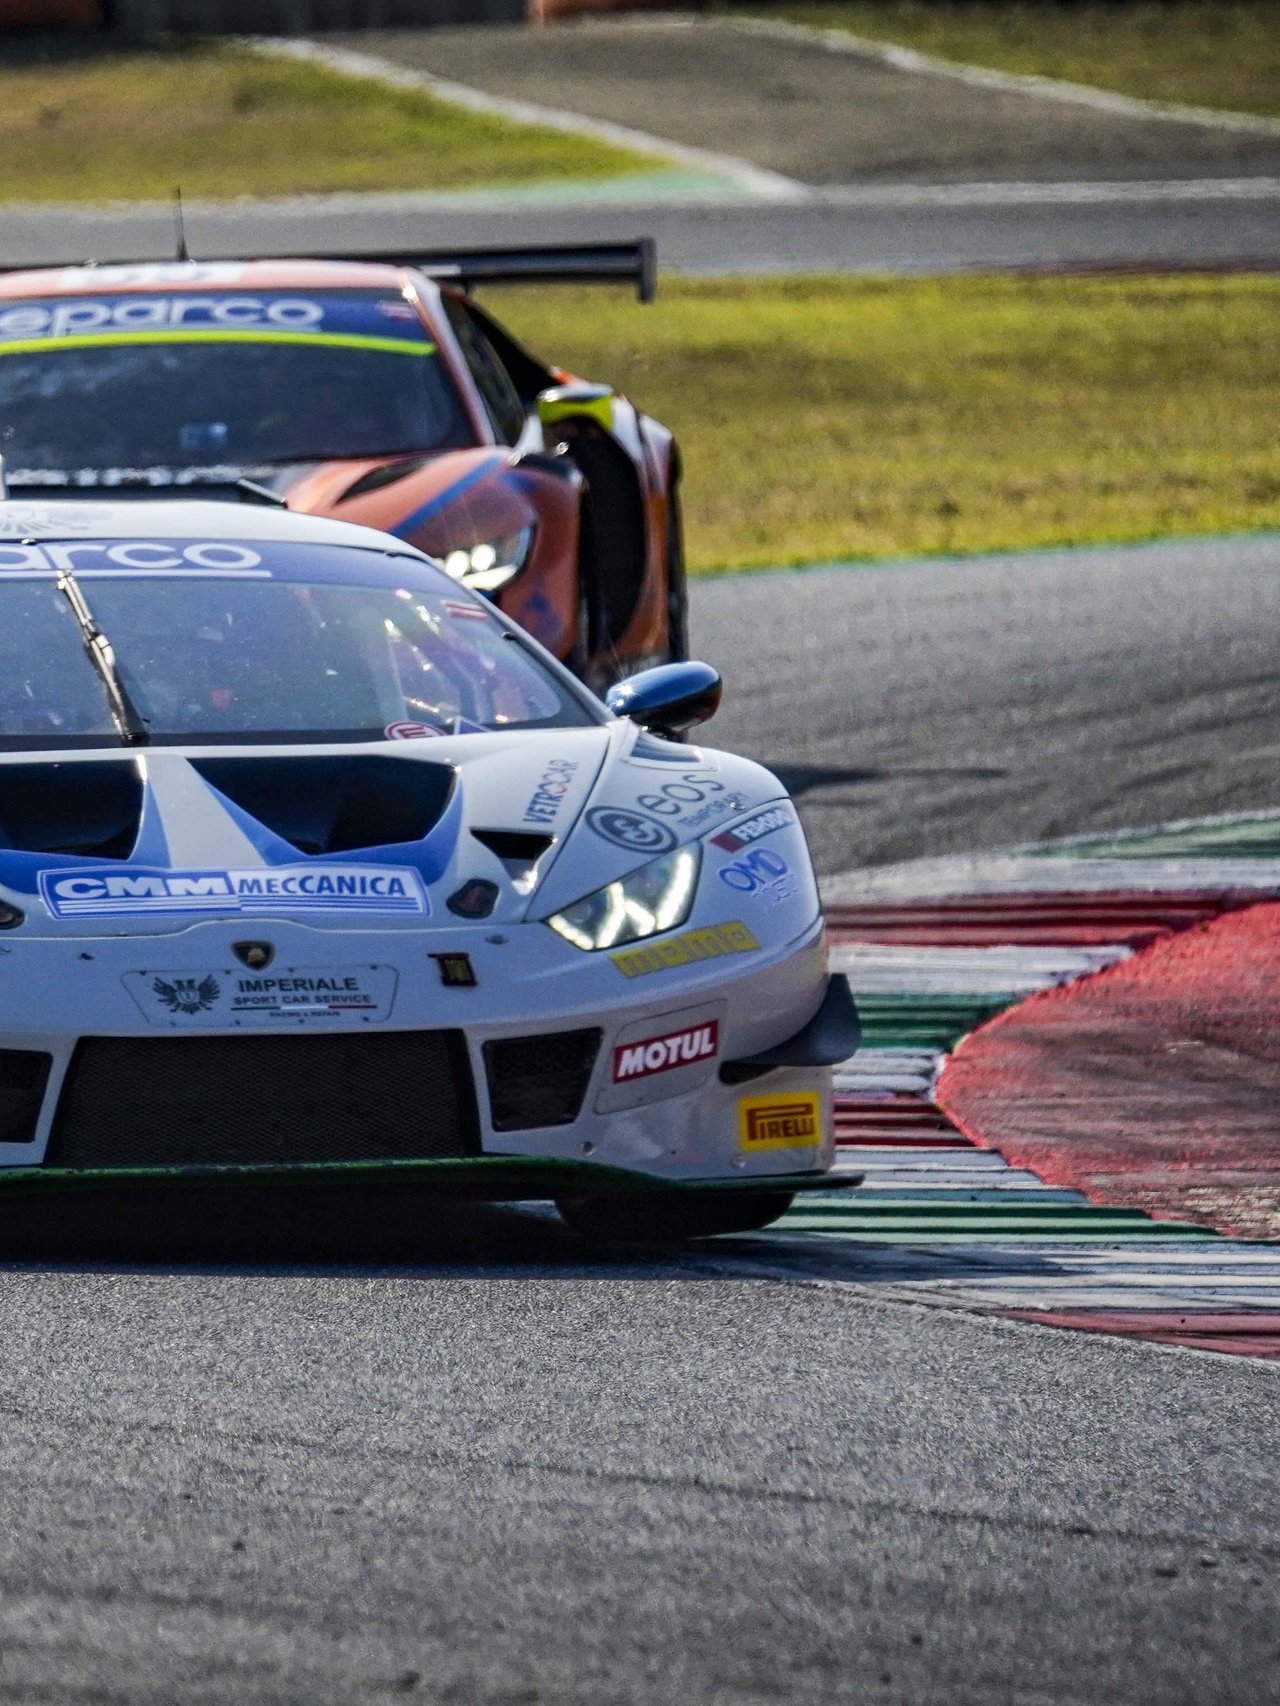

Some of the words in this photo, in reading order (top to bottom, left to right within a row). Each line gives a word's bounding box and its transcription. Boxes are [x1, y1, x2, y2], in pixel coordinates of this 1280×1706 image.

[637, 774, 725, 815] eos
[54, 876, 228, 899] CMM
[238, 875, 407, 896] MECCANICA
[718, 848, 788, 892] OMD
[233, 996, 277, 1006] SPORT
[282, 995, 310, 1005] CAR
[314, 994, 371, 1004] SERVICE
[238, 977, 360, 992] IMPERIALE
[617, 1027, 714, 1079] MOTUL
[746, 1102, 815, 1141] PIRELLI
